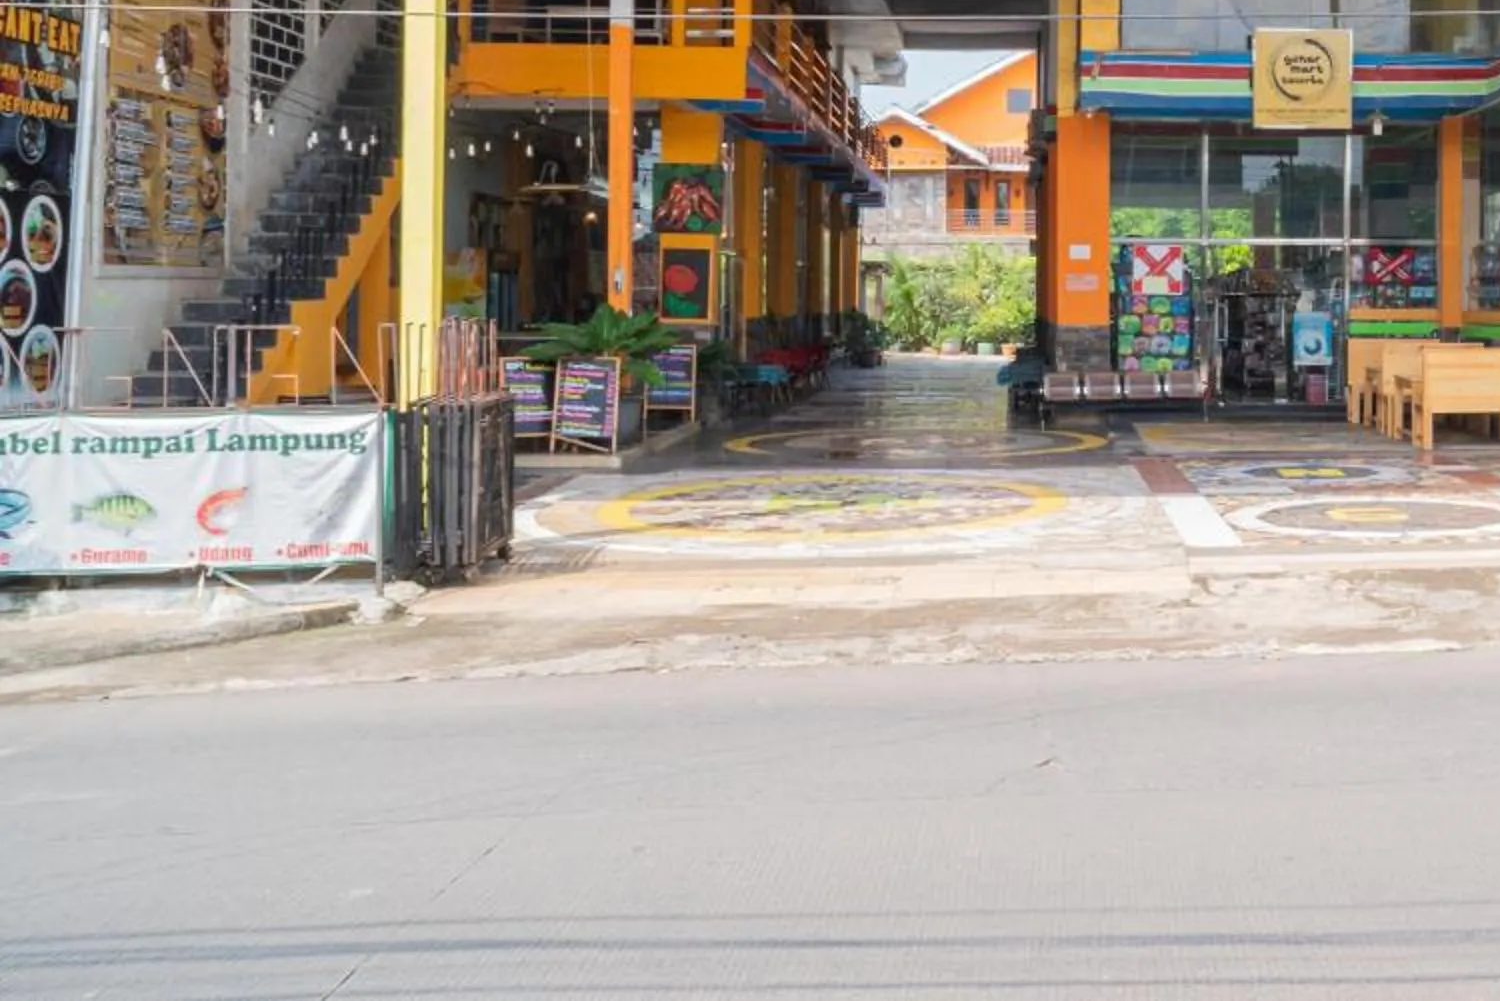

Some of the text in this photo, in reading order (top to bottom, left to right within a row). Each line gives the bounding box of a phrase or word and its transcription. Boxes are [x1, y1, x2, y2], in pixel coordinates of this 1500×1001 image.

[71, 428, 196, 459] rampai
[205, 428, 368, 457] Lampung
[199, 543, 252, 562] Udang
